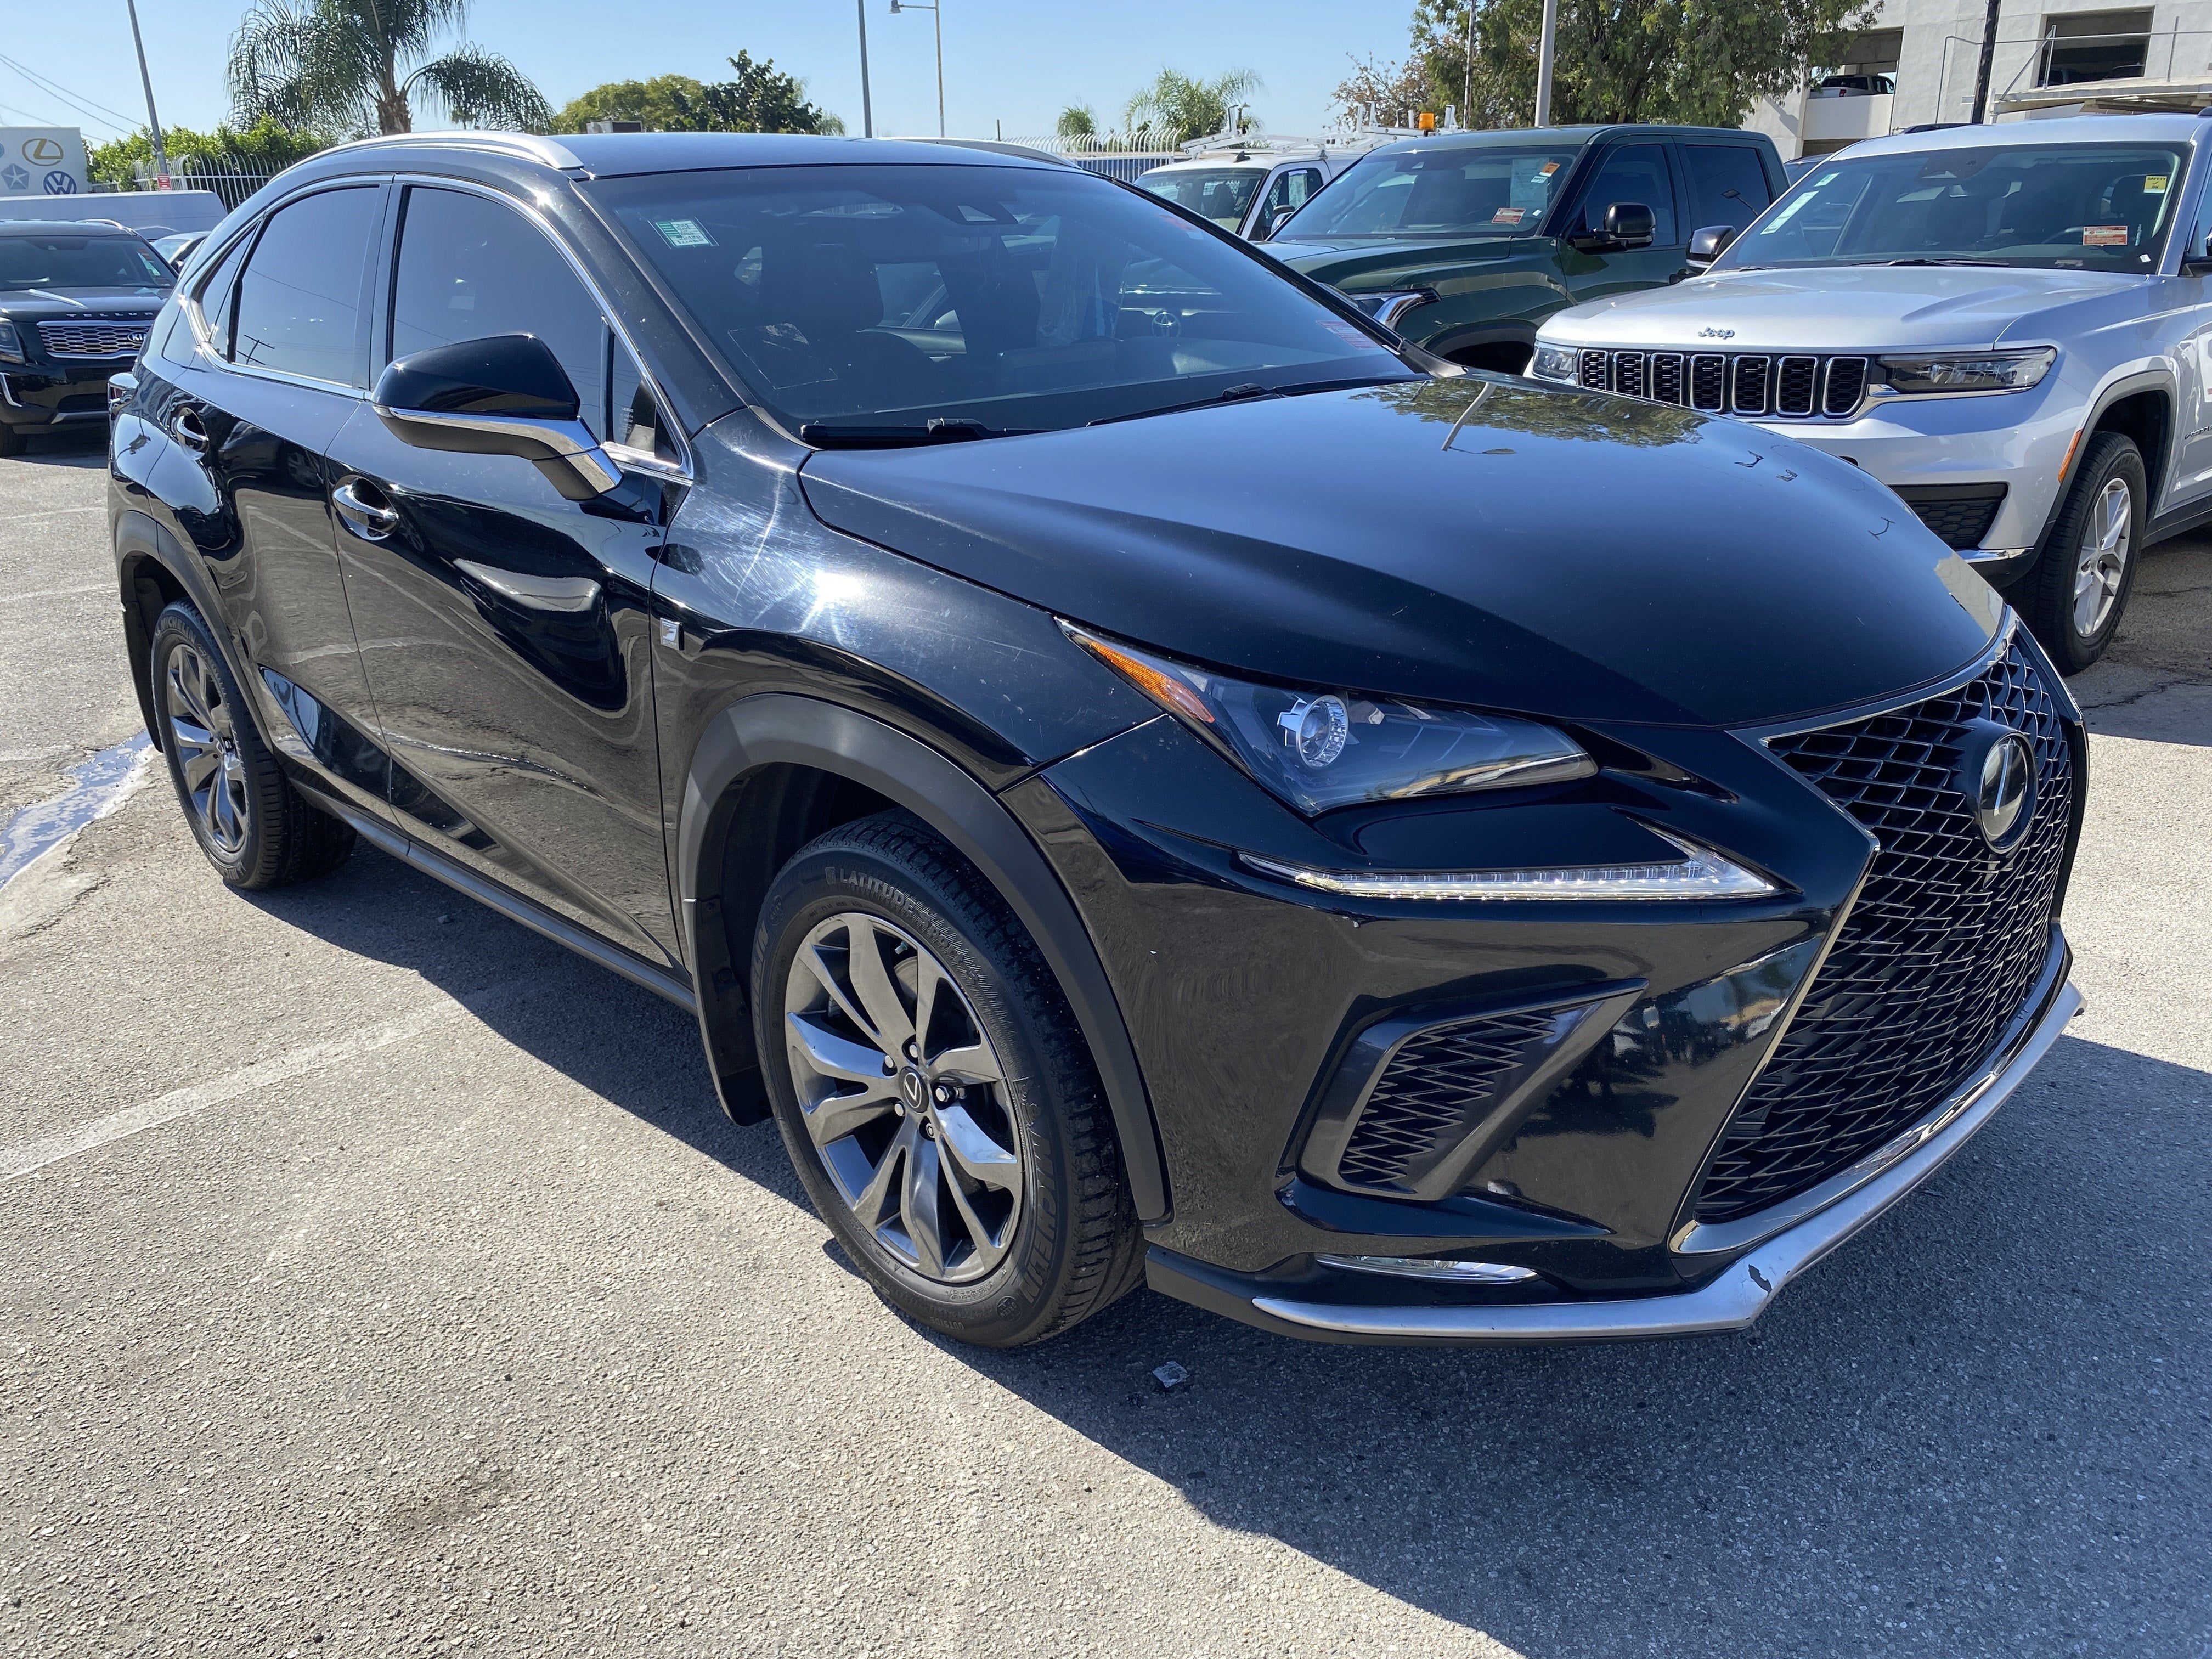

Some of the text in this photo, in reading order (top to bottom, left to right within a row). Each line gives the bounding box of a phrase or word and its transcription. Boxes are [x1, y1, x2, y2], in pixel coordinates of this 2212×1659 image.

[1698, 326, 1735, 340] Jeep
[839, 868, 917, 914] LATITUDE
[1019, 1131, 1057, 1304] MICHELIN
